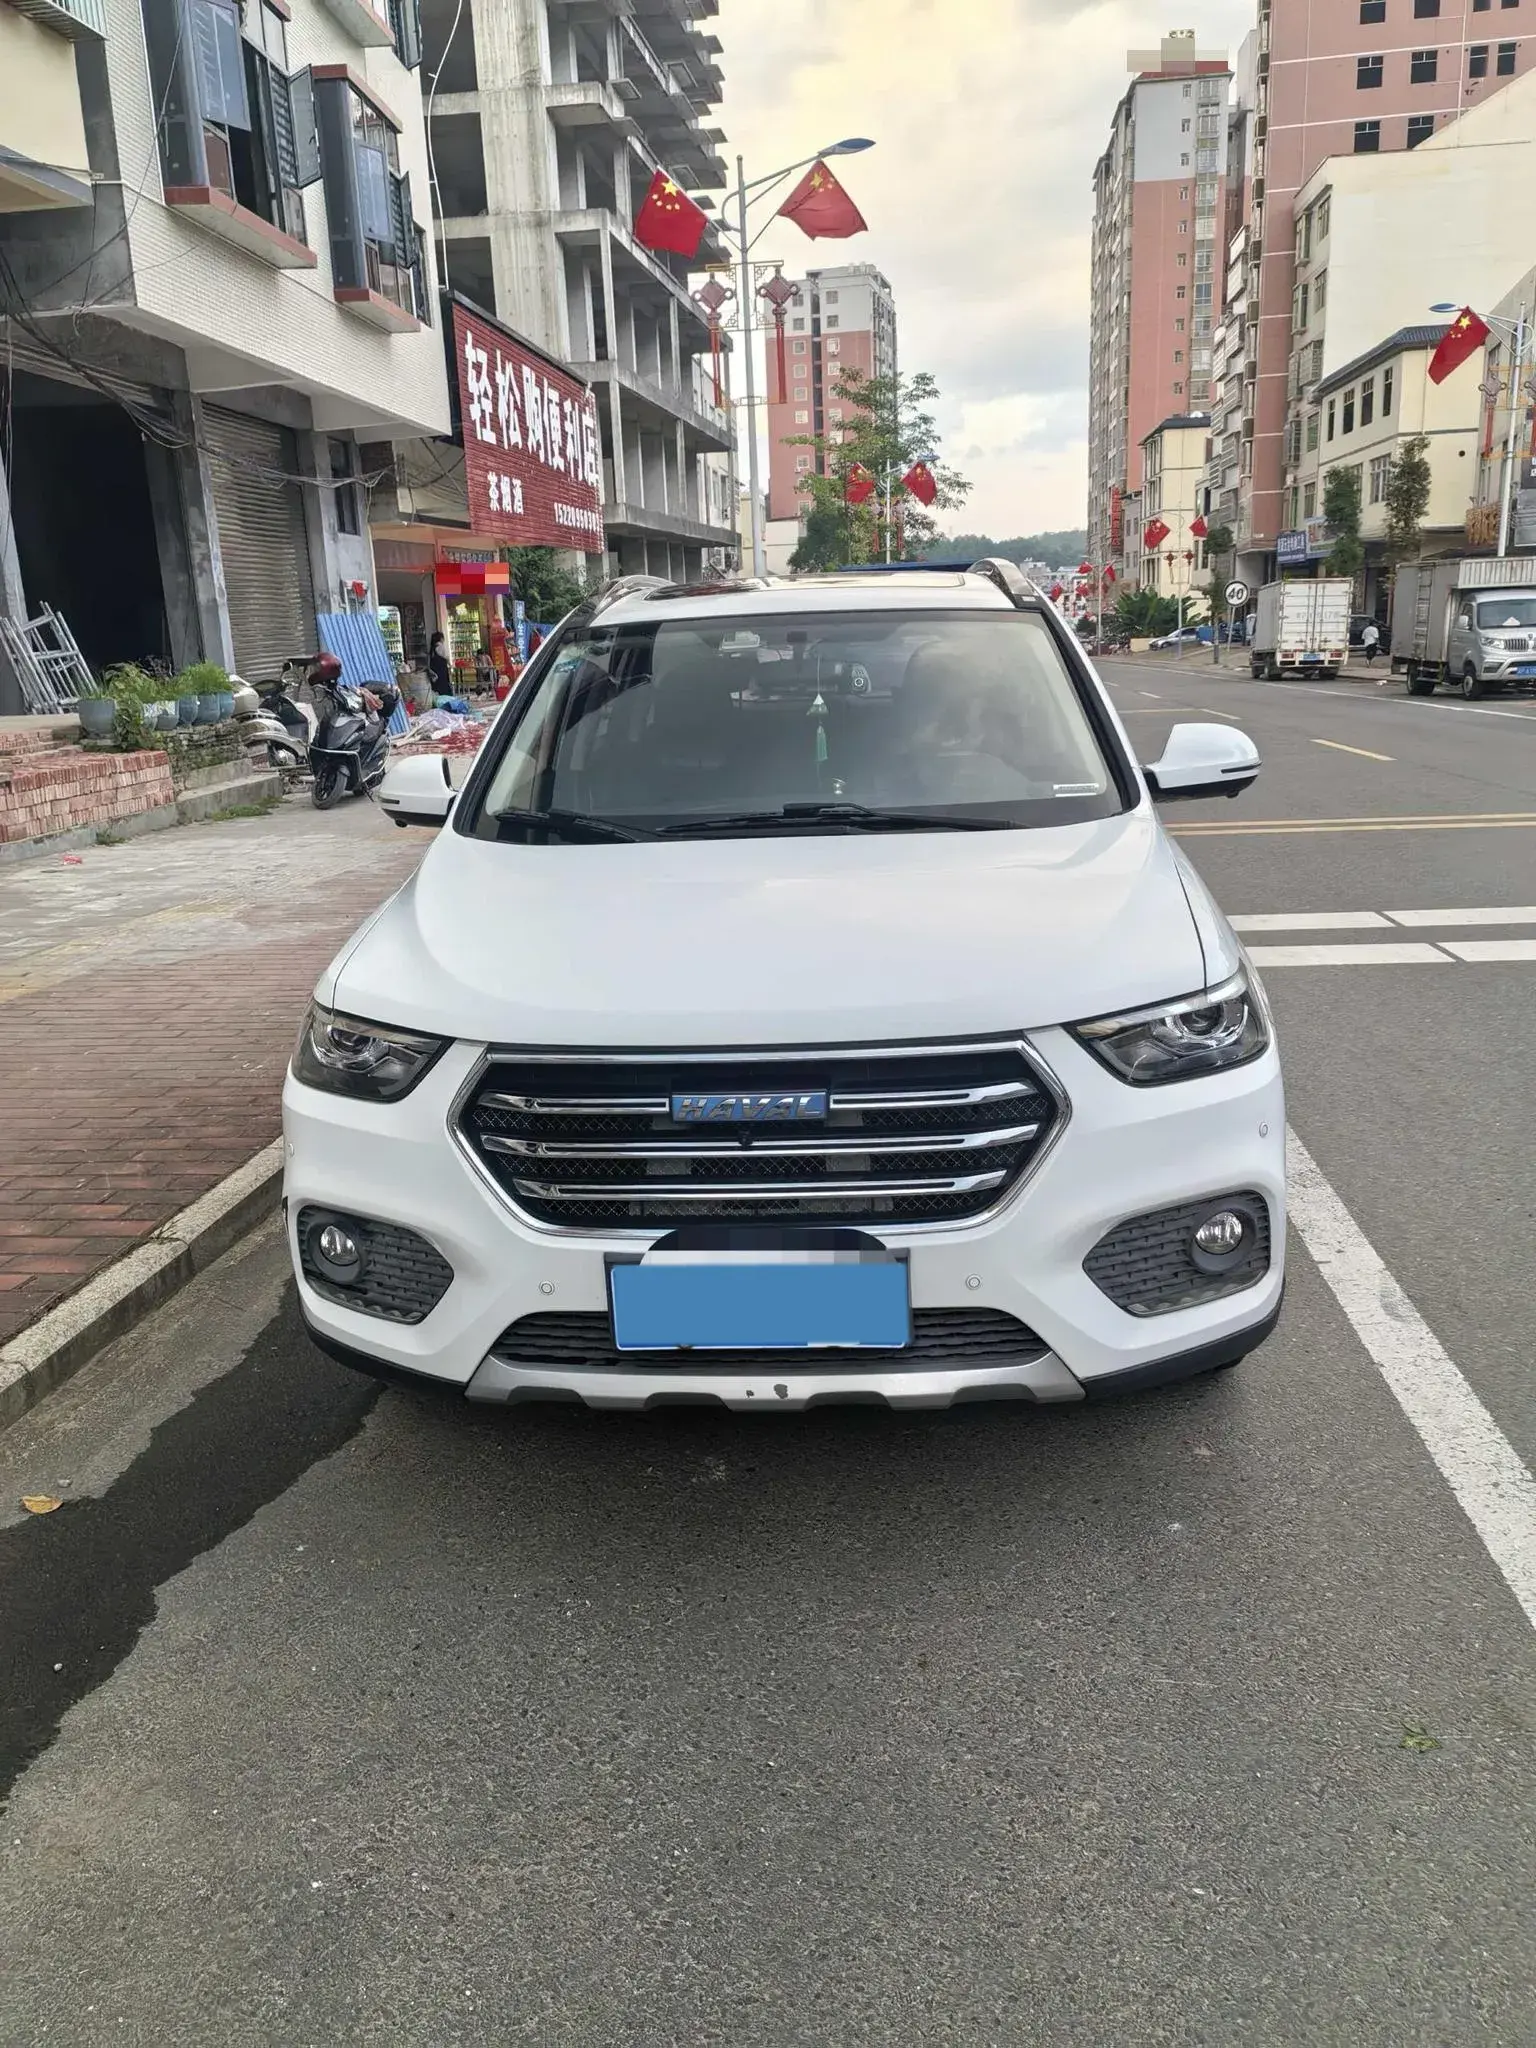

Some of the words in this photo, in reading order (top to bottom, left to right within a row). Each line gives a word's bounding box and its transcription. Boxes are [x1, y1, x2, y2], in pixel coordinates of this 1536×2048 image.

[464, 330, 600, 487] 轻松购便利店
[487, 471, 524, 515] 茶烟酒
[1228, 588, 1244, 600] 40
[680, 1097, 824, 1120] HAVAL
